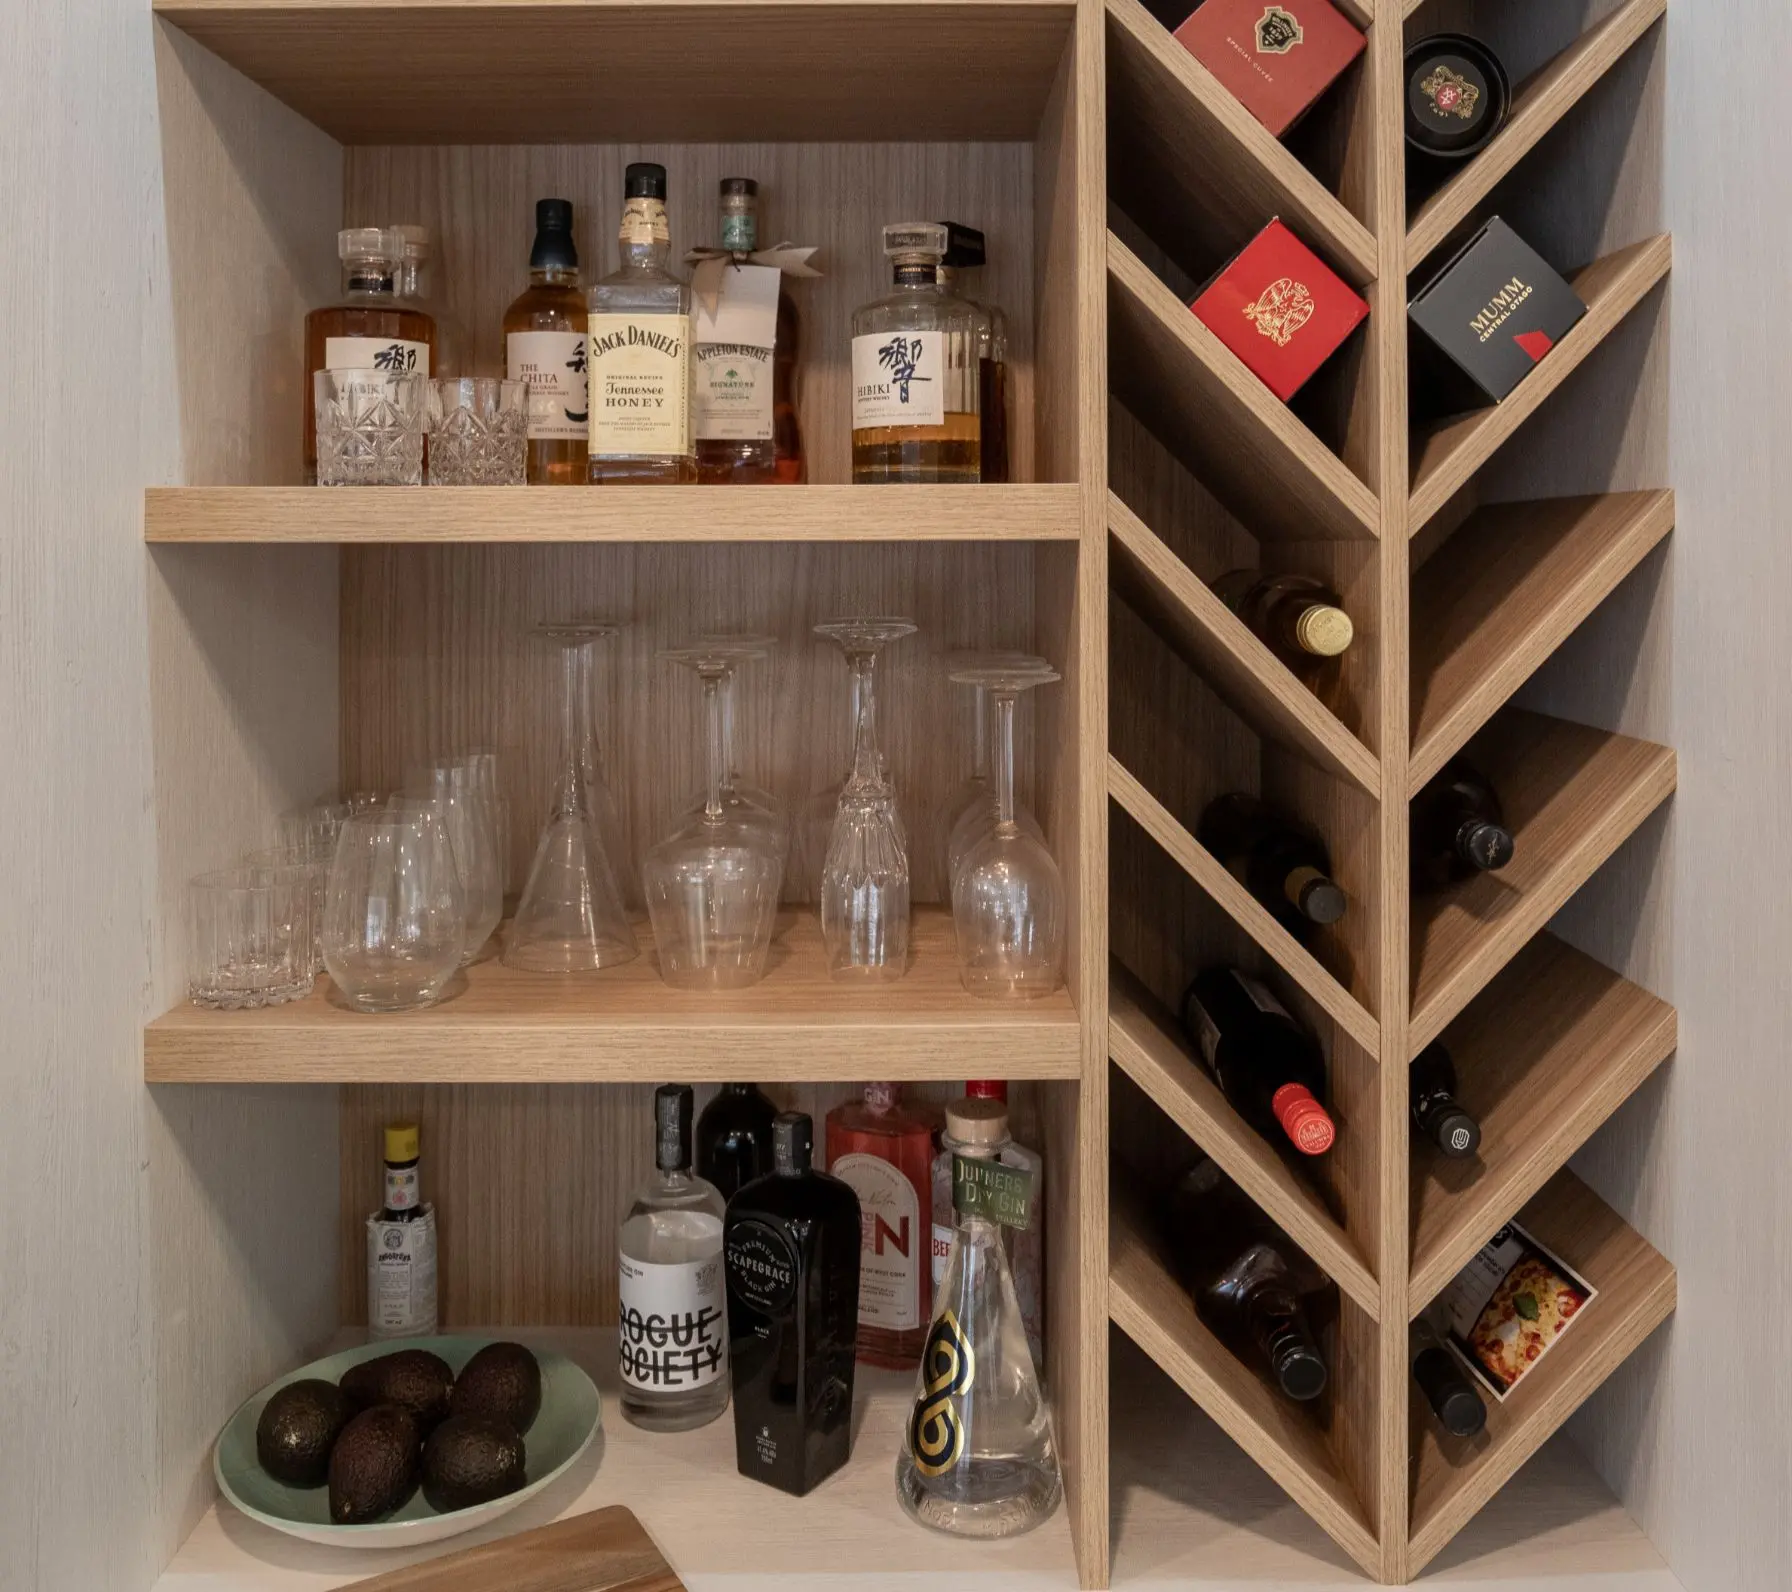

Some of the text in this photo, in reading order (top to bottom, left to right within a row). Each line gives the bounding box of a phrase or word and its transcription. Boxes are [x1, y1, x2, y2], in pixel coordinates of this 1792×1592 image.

[1226, 36, 1252, 62] SPECIAL
[1469, 276, 1525, 334] MUMM
[1479, 286, 1533, 342] CENTRAL OTAGO
[593, 325, 682, 358] JACK DANIEL'S
[697, 344, 769, 363] APPLETON ESTATE
[520, 363, 538, 372] THE
[520, 373, 558, 383] CHITA
[879, 337, 932, 404] 響
[605, 382, 664, 395] Tennessee
[857, 383, 890, 397] HIBIKI
[606, 398, 664, 407] HONEY
[999, 1191, 1026, 1216] GIN
[378, 1252, 411, 1262] ANGOSTURA
[727, 1250, 790, 1284] SCAPEGRACE
[740, 1270, 777, 1293] BLACK GIN
[620, 1298, 713, 1348] ROGUE
[619, 1338, 722, 1385] OCIETY
